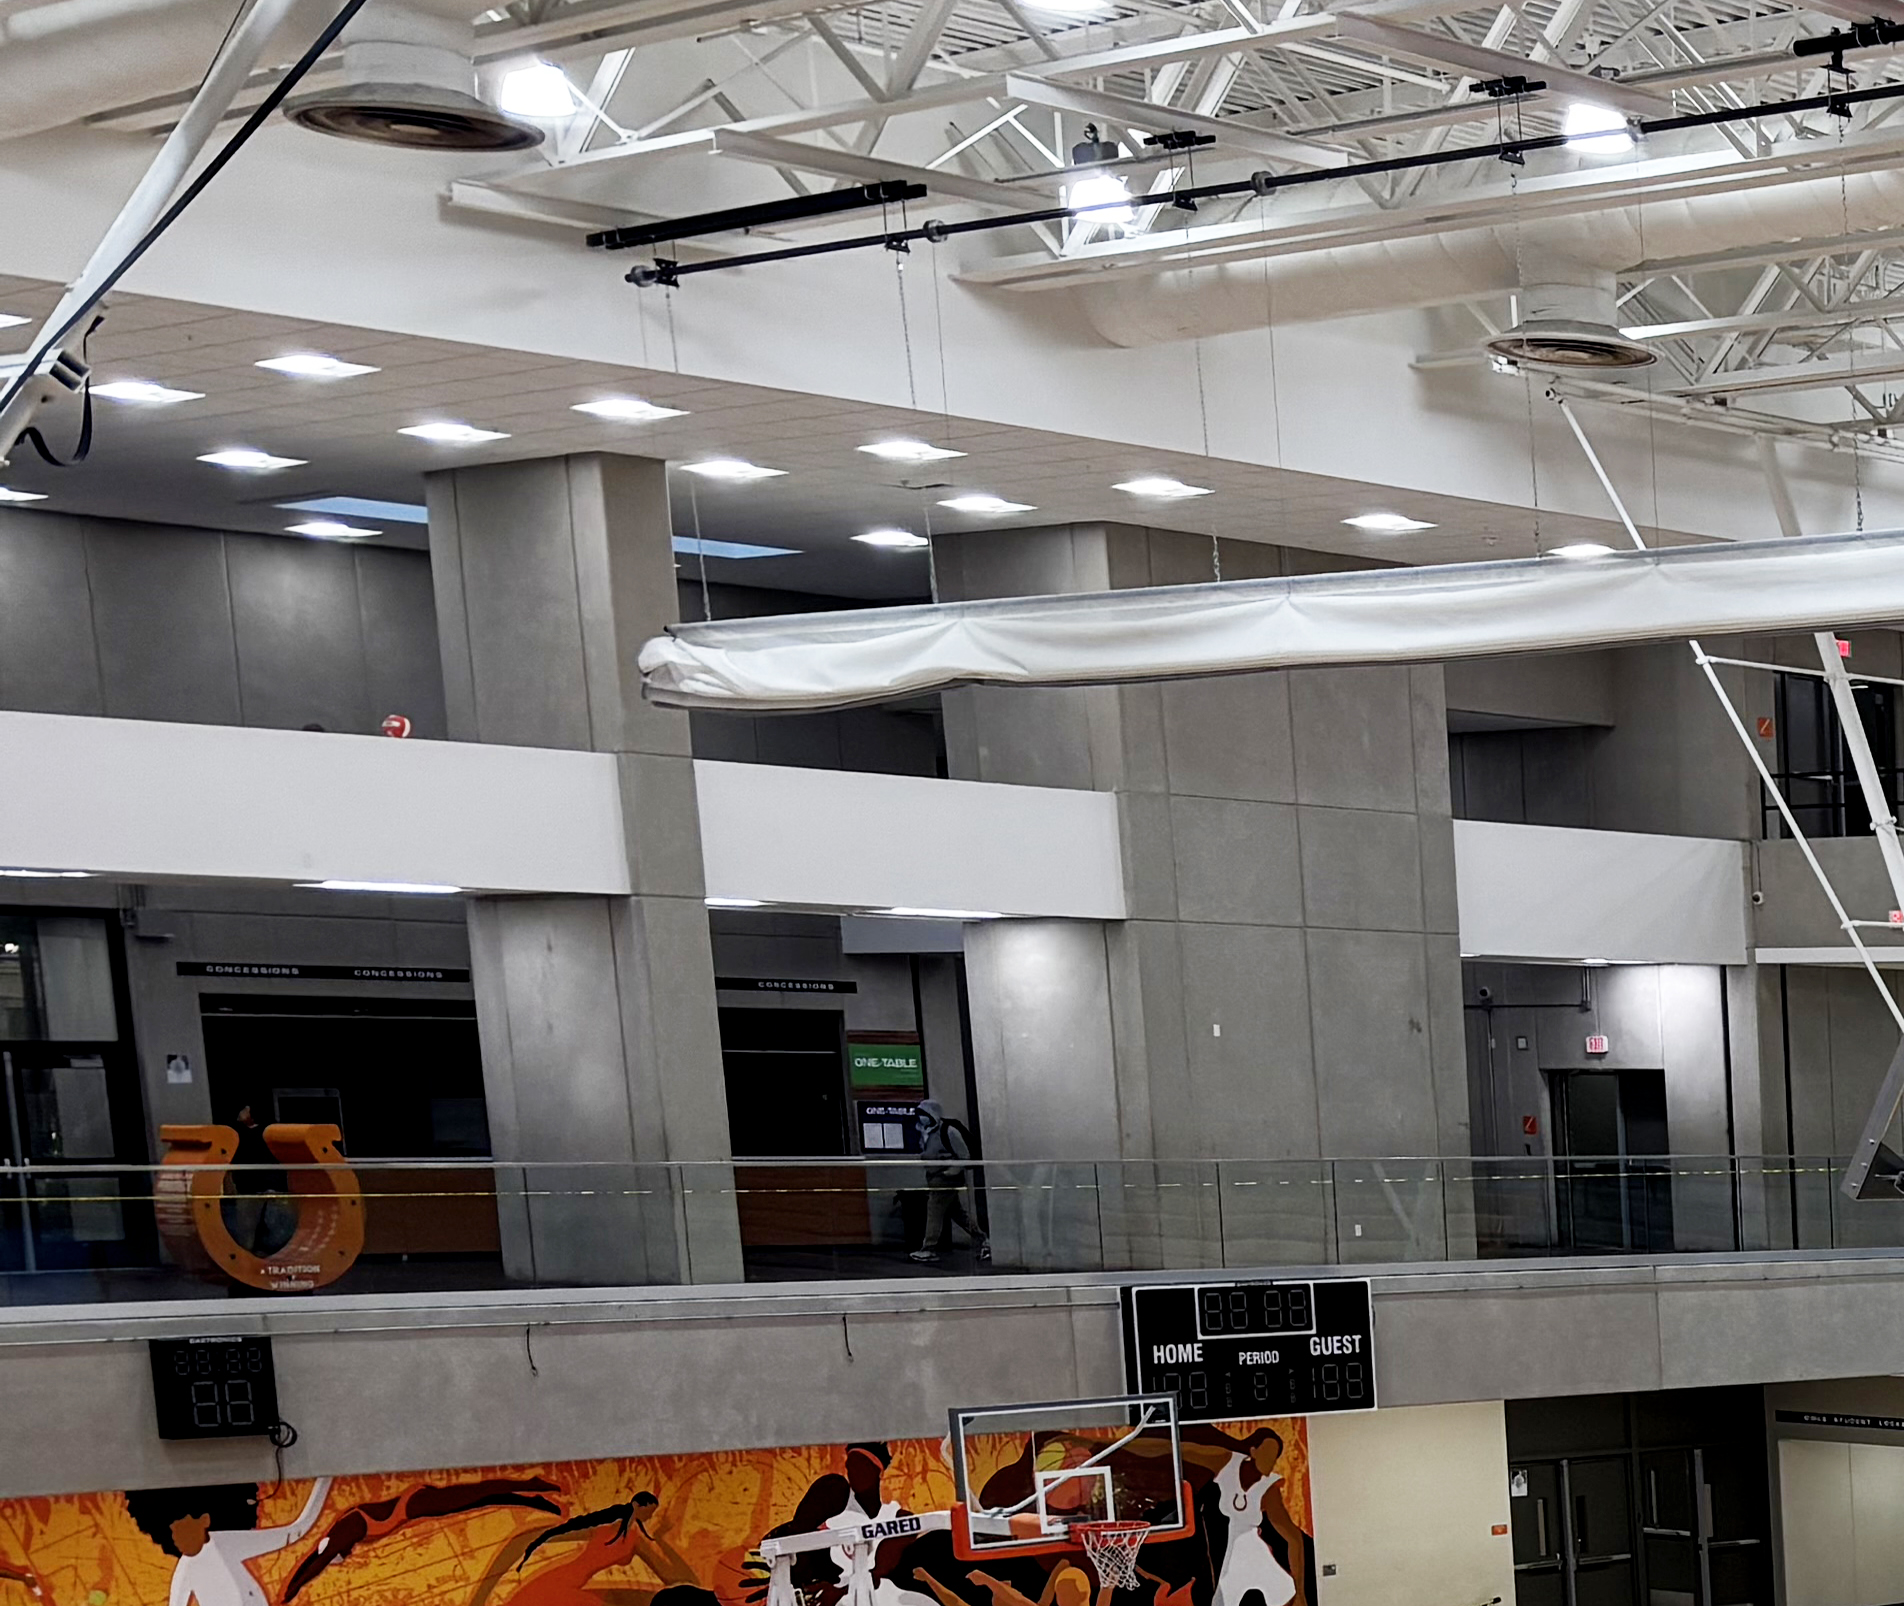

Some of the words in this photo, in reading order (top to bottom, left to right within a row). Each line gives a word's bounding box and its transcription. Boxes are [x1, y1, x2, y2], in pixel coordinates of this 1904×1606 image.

[1152, 1343, 1204, 1364] HOME
[1309, 1334, 1362, 1356] GUEST
[1238, 1350, 1279, 1365] PERIOD
[861, 1516, 921, 1539] GARED
